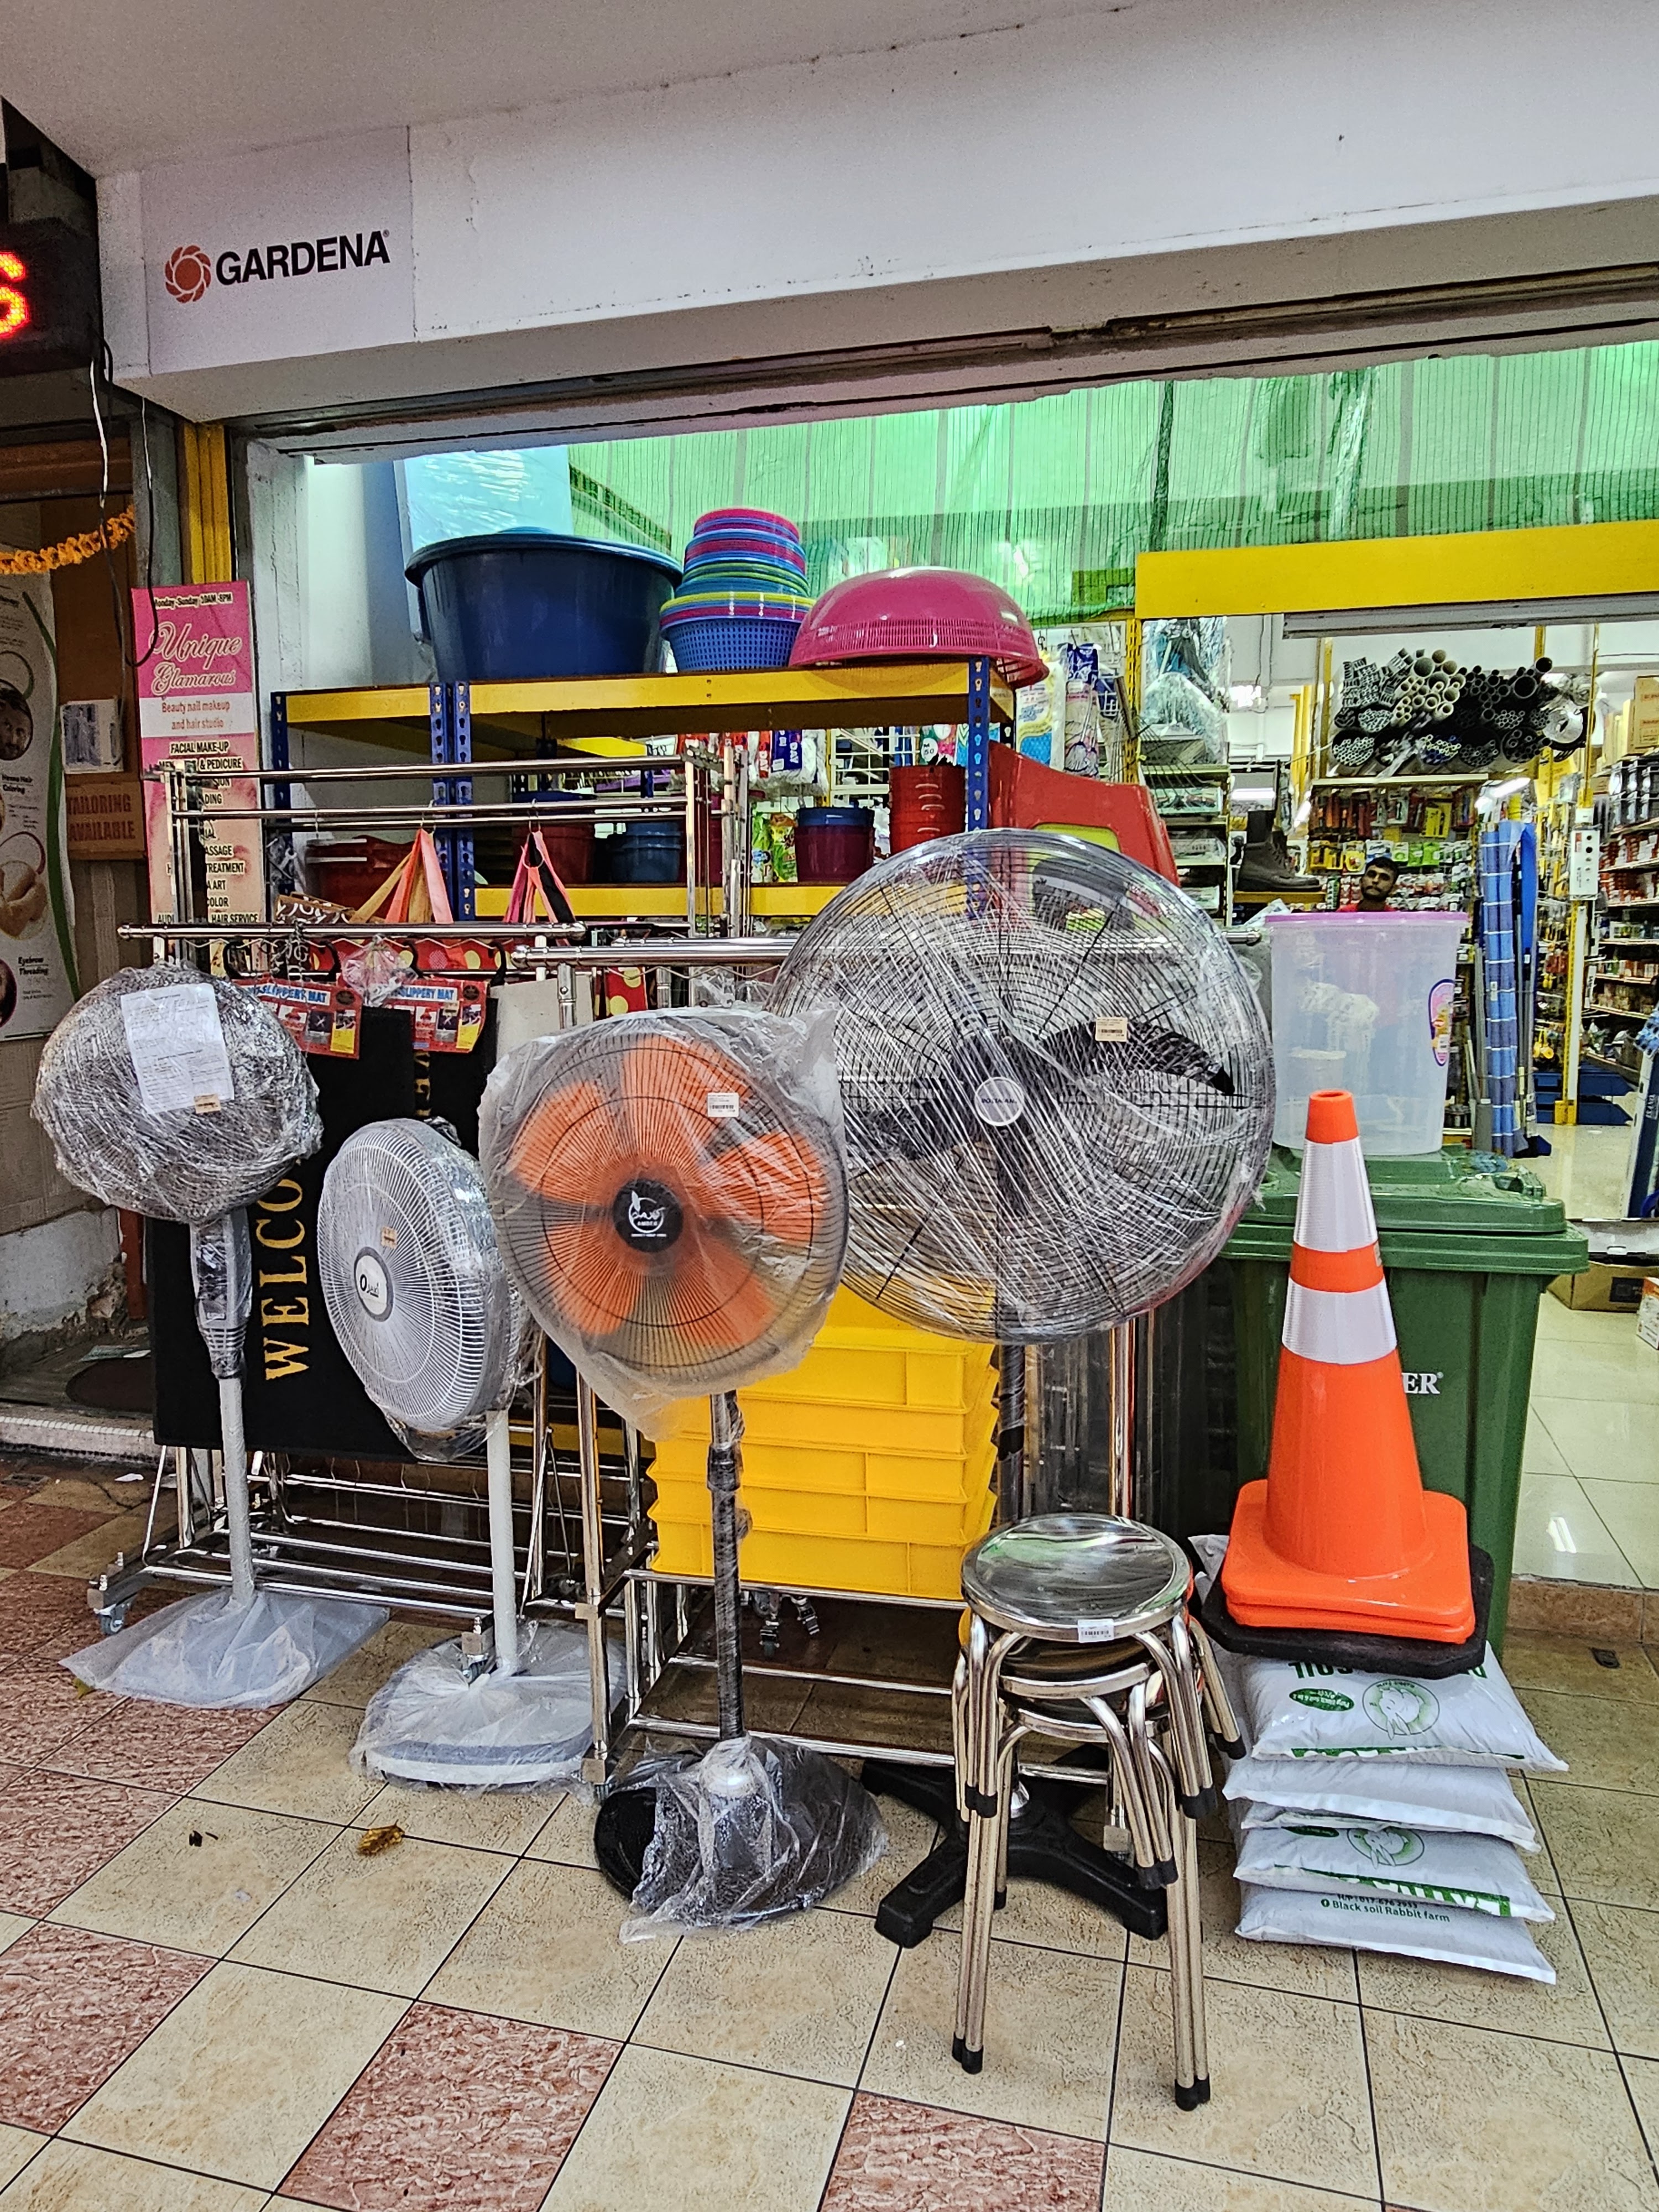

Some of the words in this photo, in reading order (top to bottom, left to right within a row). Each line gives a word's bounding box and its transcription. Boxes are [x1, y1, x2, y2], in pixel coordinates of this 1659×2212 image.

[216, 231, 390, 285] GARDENA
[148, 622, 242, 670] Unique
[170, 743, 195, 754] FACIAL
[197, 741, 229, 753] MAKE-UP
[207, 758, 242, 770] PEDICURE
[67, 793, 131, 815] TAILORING
[69, 821, 135, 841] AVAILABLE
[206, 846, 232, 856] ASSAGE
[256, 1178, 310, 1380] WELCO
[1401, 1372, 1440, 1394] ER
[1333, 1901, 1361, 1912] Black
[1364, 1905, 1383, 1914] soil
[1385, 1906, 1422, 1919] Rabbit
[1424, 1911, 1450, 1923] farm
